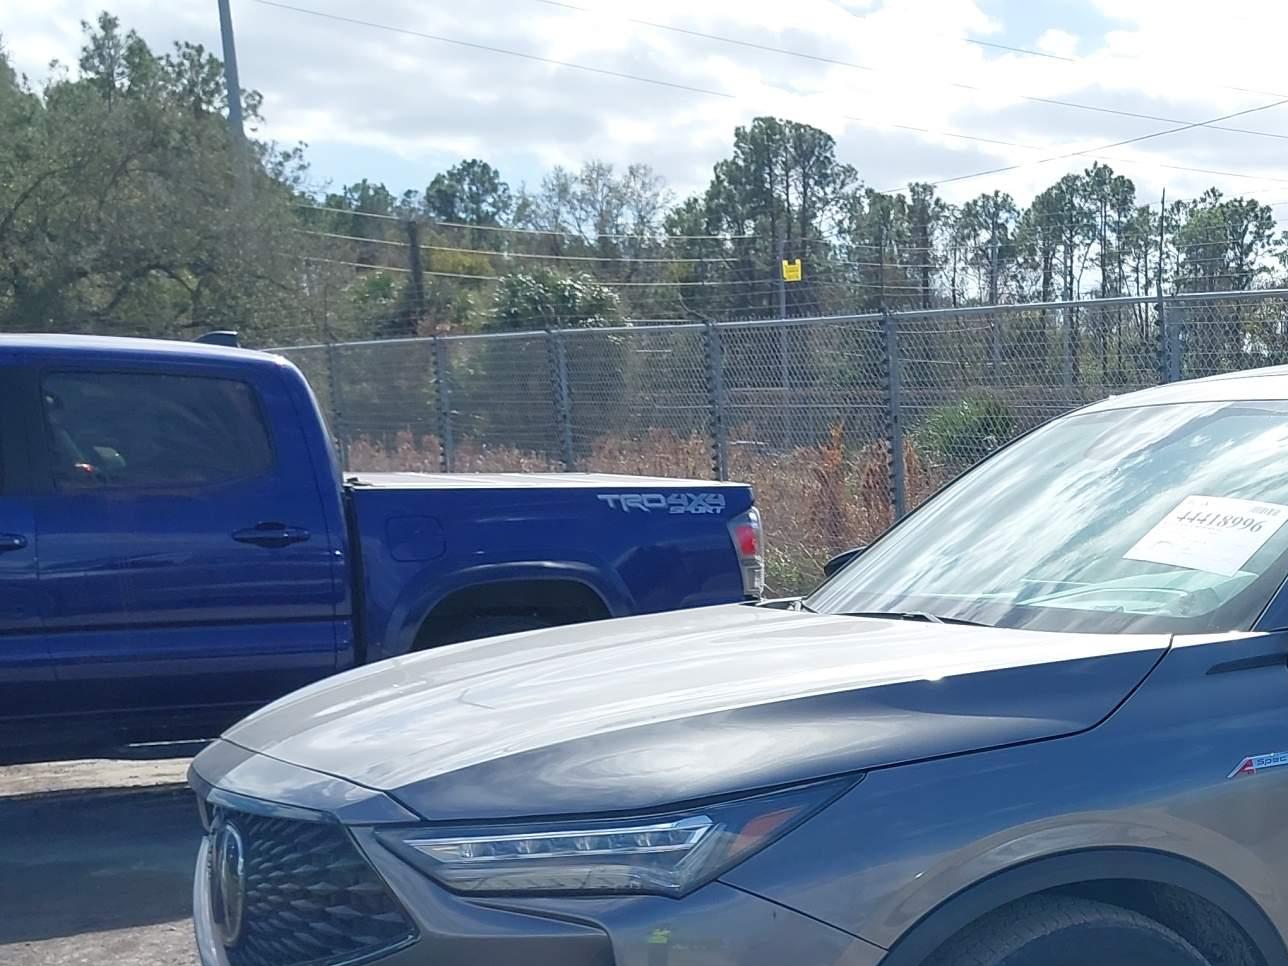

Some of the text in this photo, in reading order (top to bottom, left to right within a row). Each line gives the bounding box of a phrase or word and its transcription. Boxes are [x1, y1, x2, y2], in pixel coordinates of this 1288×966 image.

[597, 493, 667, 512] TRD
[669, 505, 725, 514] SPORT
[1177, 511, 1267, 533] 44418996
